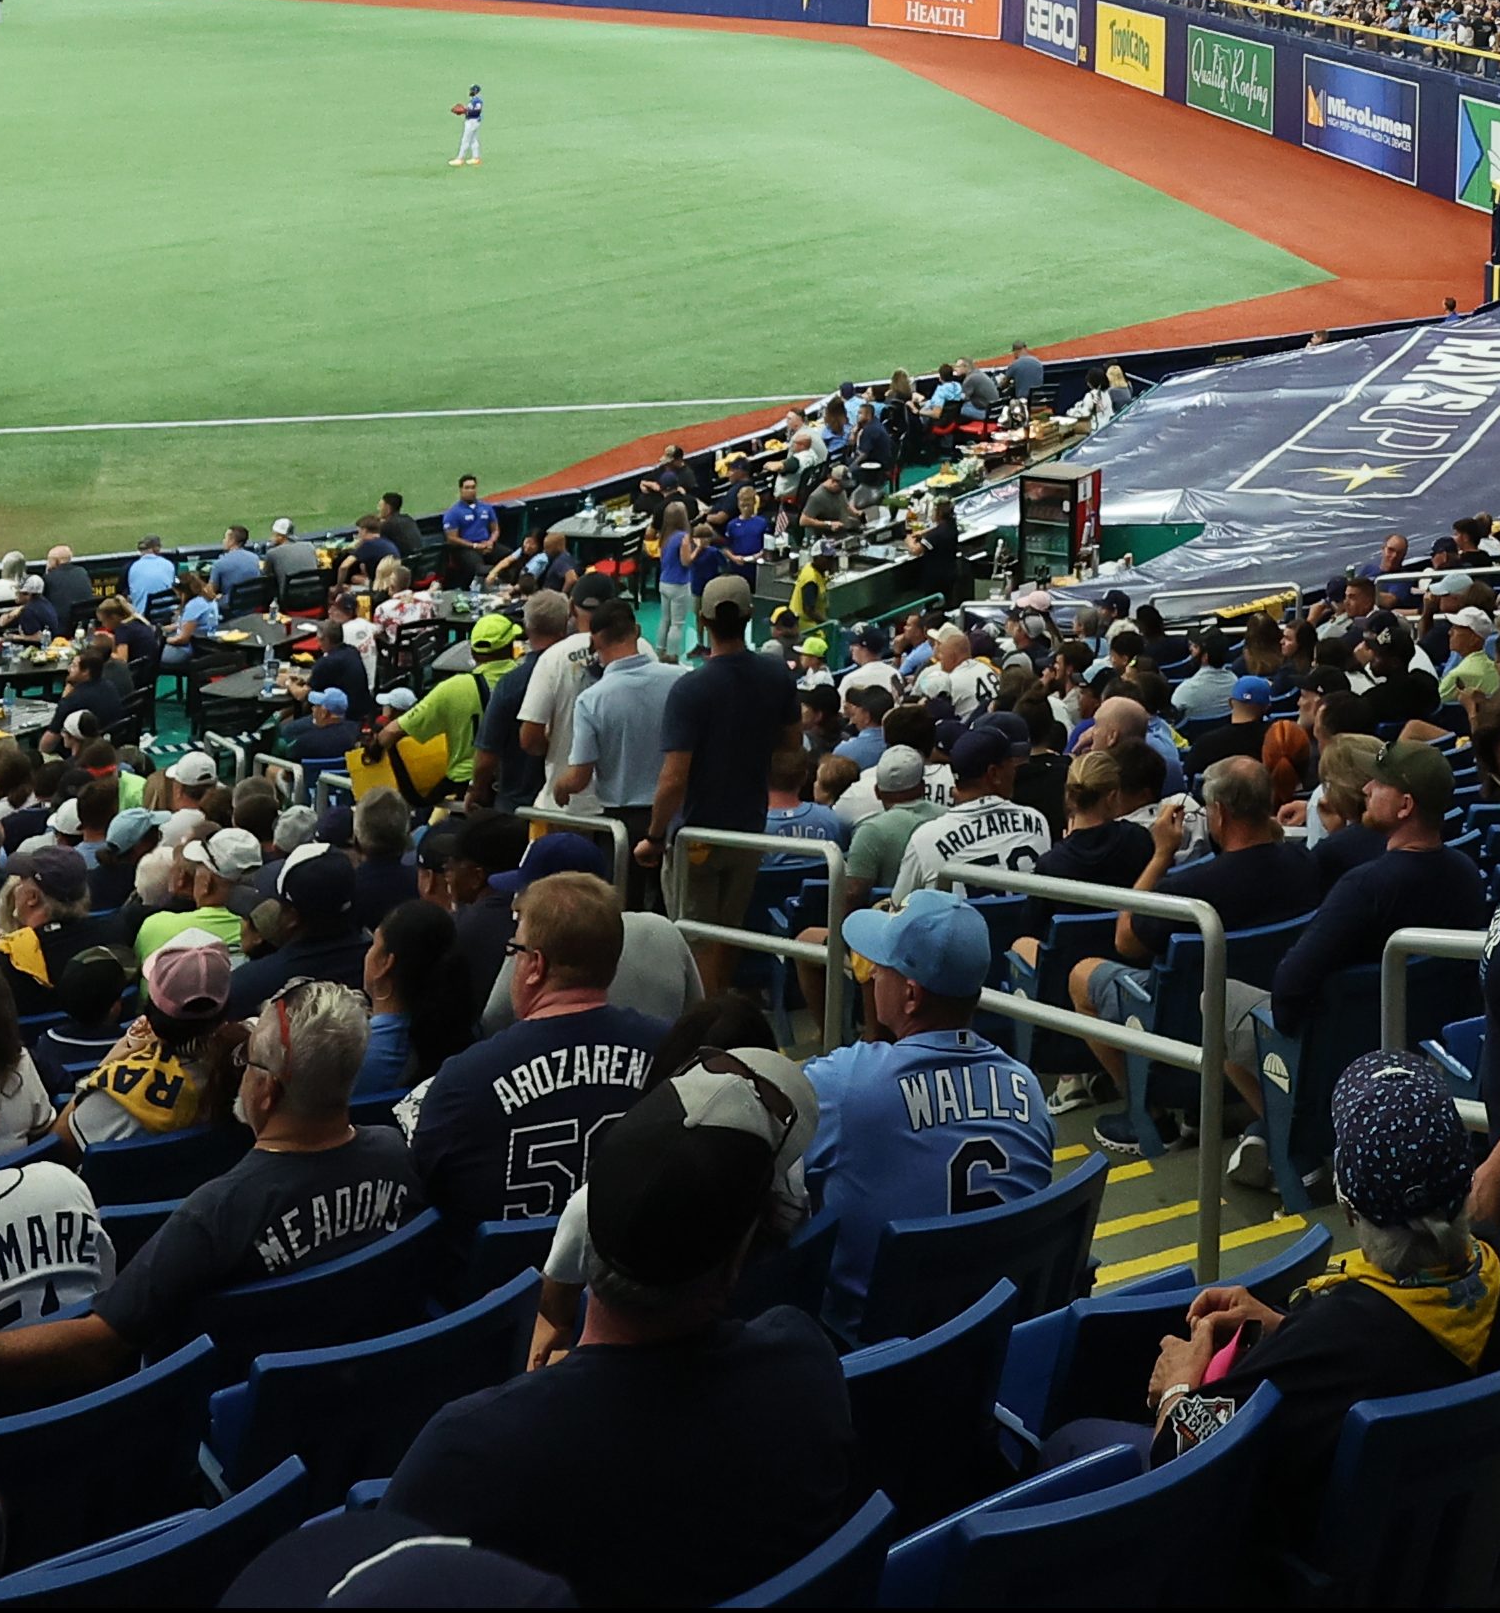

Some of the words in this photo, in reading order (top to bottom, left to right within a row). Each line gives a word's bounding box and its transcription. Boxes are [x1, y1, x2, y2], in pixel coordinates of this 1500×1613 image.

[905, 0, 966, 29] HEALTH
[1109, 18, 1150, 72] Tropicana
[1191, 37, 1229, 91] Quality
[1230, 48, 1269, 119] Roofing
[1327, 94, 1412, 140] MicroLumen
[935, 813, 1044, 862] AROZARENA
[899, 1065, 1031, 1131] WALLS
[253, 1181, 409, 1274] MEADOWS
